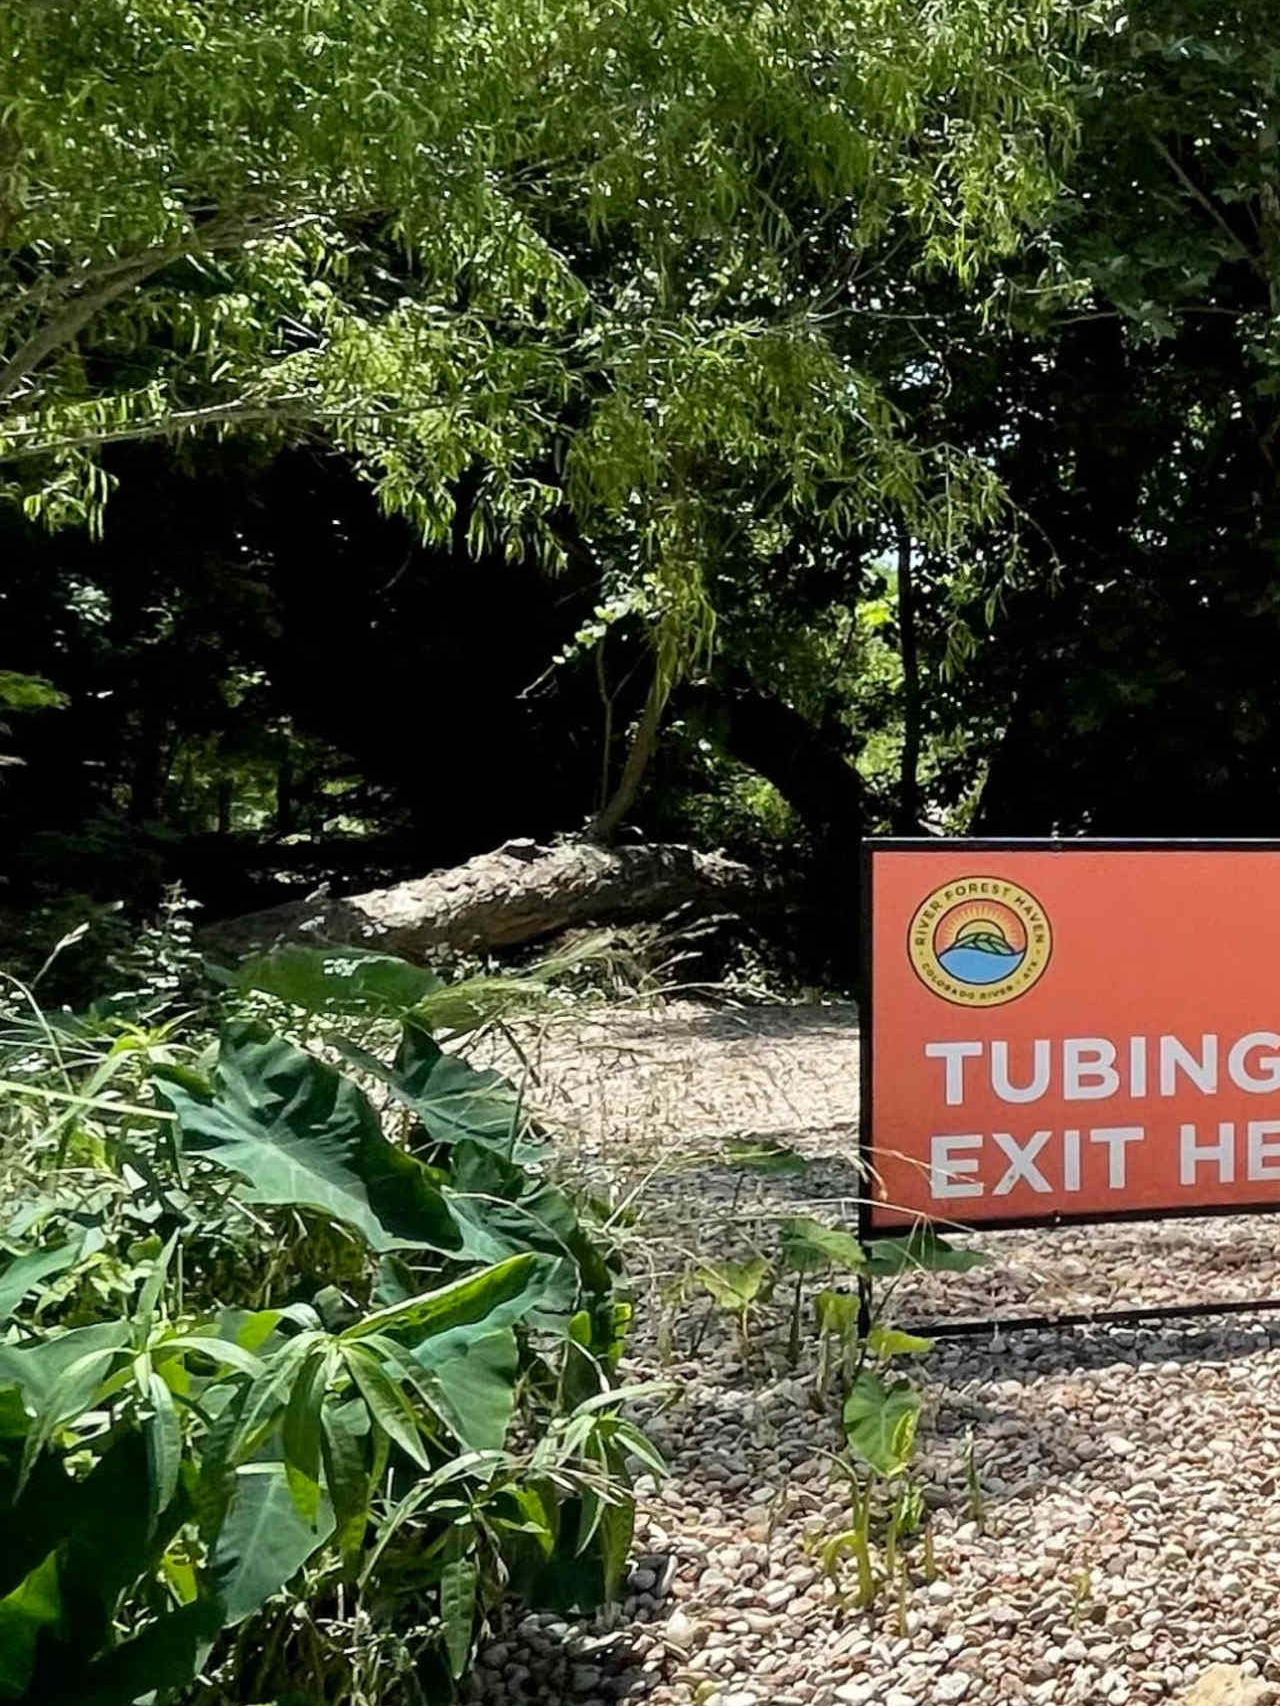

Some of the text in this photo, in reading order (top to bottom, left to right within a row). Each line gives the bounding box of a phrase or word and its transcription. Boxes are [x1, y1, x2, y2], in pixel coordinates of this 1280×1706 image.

[915, 882, 1046, 945] RIVER FOREST HAVEN
[922, 962, 976, 1000] COLORADO
[930, 1125, 1145, 1200] EXIT
